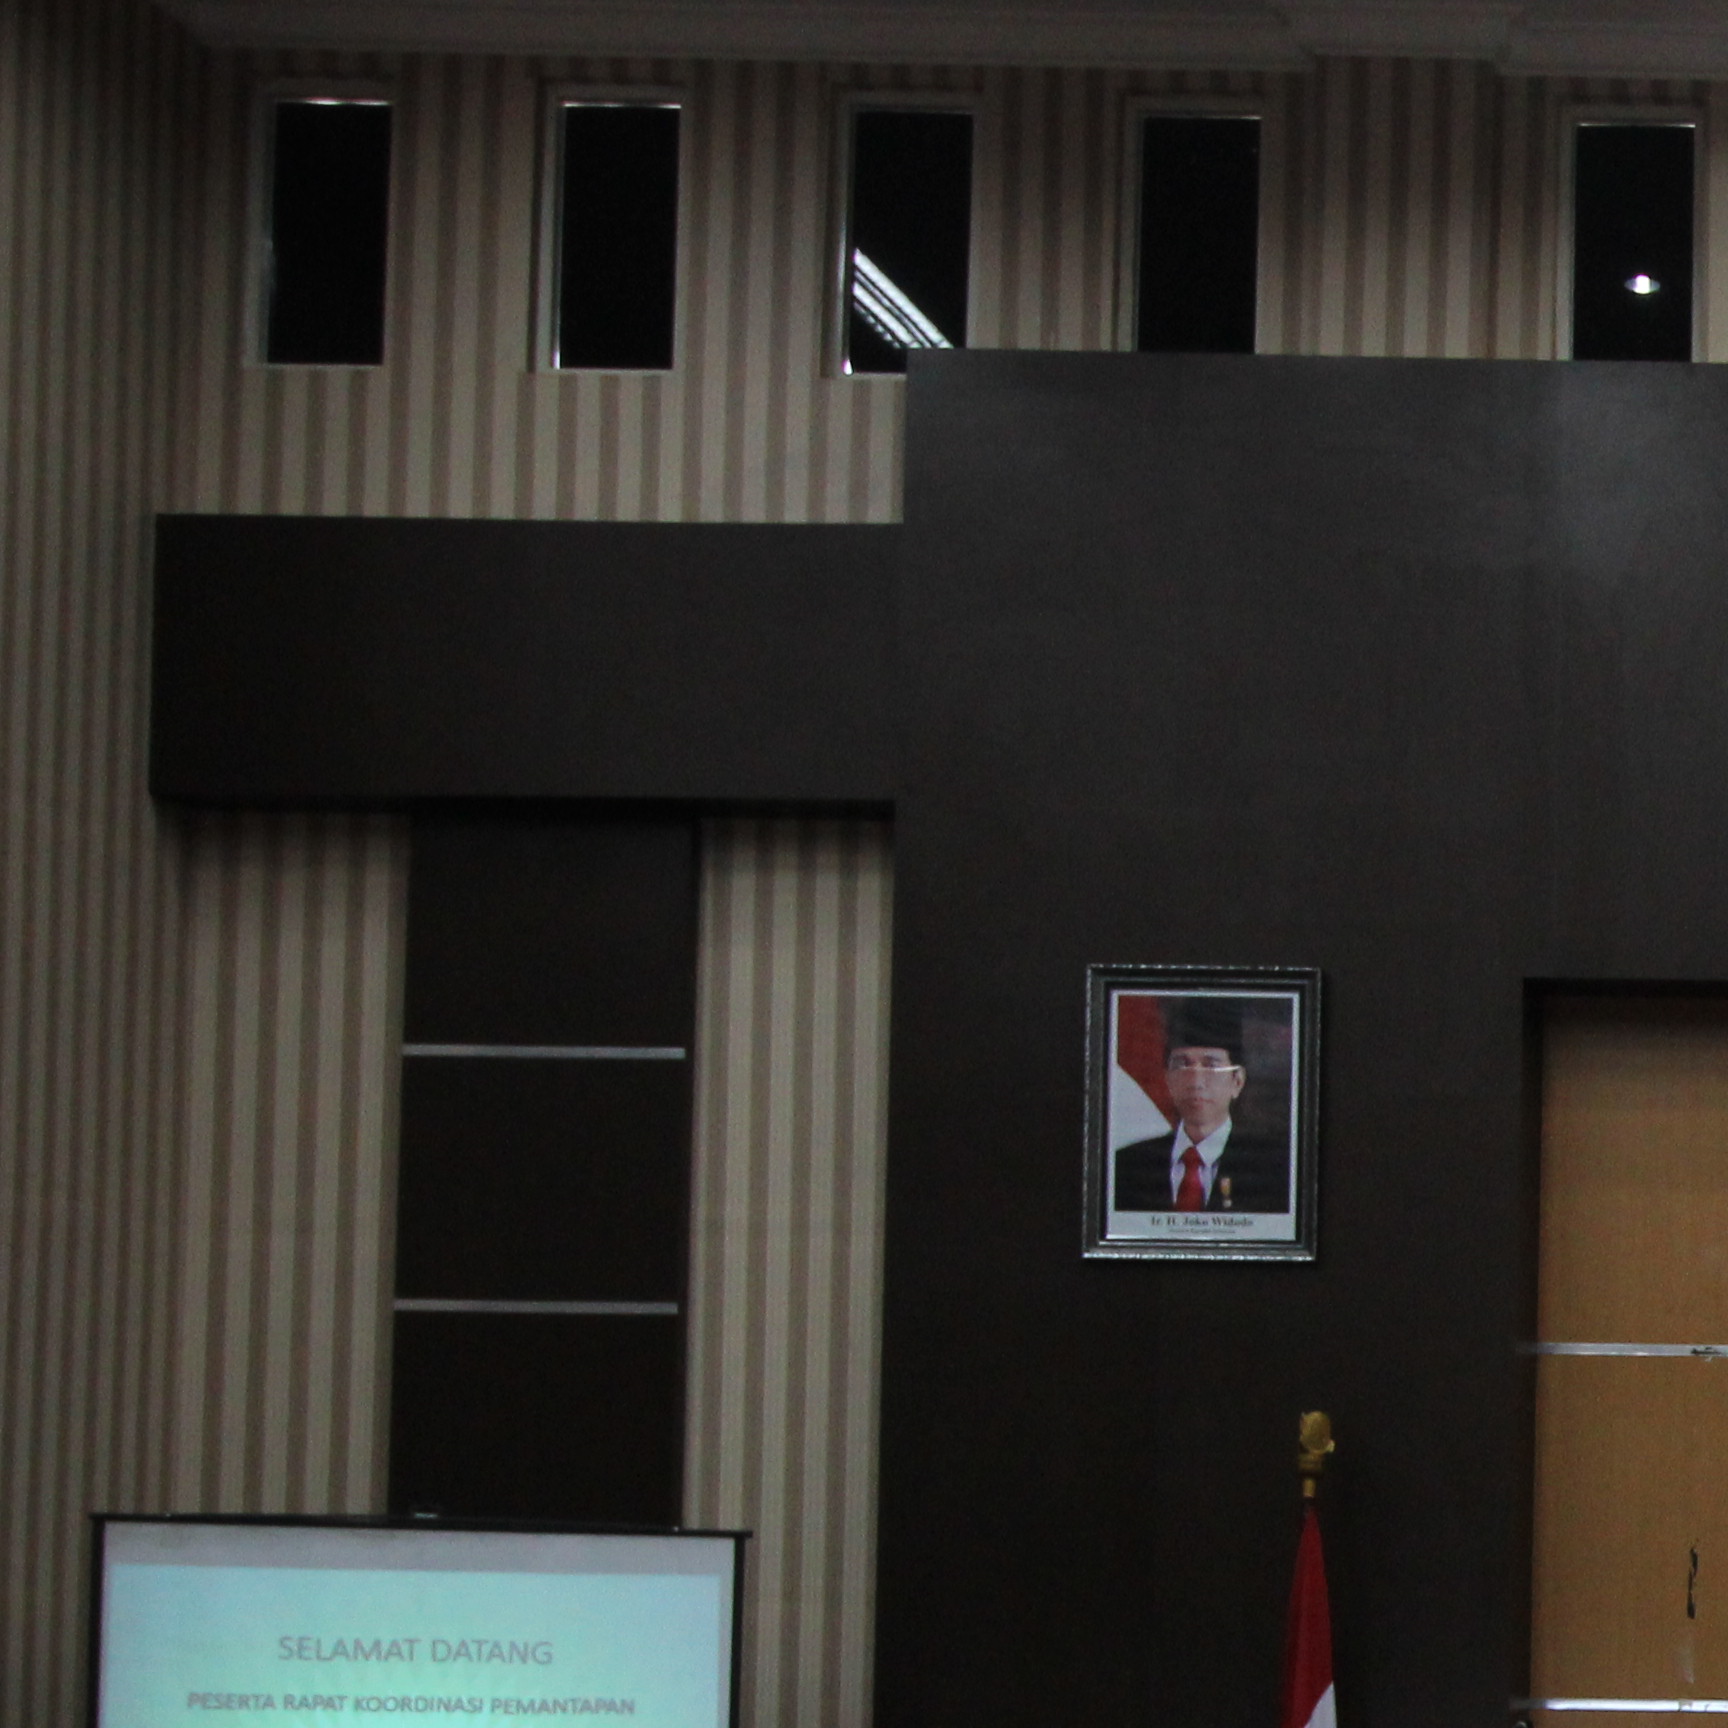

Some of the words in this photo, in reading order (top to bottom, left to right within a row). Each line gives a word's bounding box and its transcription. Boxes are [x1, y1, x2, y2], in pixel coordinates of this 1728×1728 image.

[279, 1635, 421, 1662] SELAMAT
[432, 1638, 553, 1665] DATANG
[187, 1692, 276, 1710] PESERTA
[284, 1694, 347, 1711] RAPAT
[354, 1696, 483, 1713] KOORDINASI
[492, 1698, 635, 1715] PEMANTAPAN
